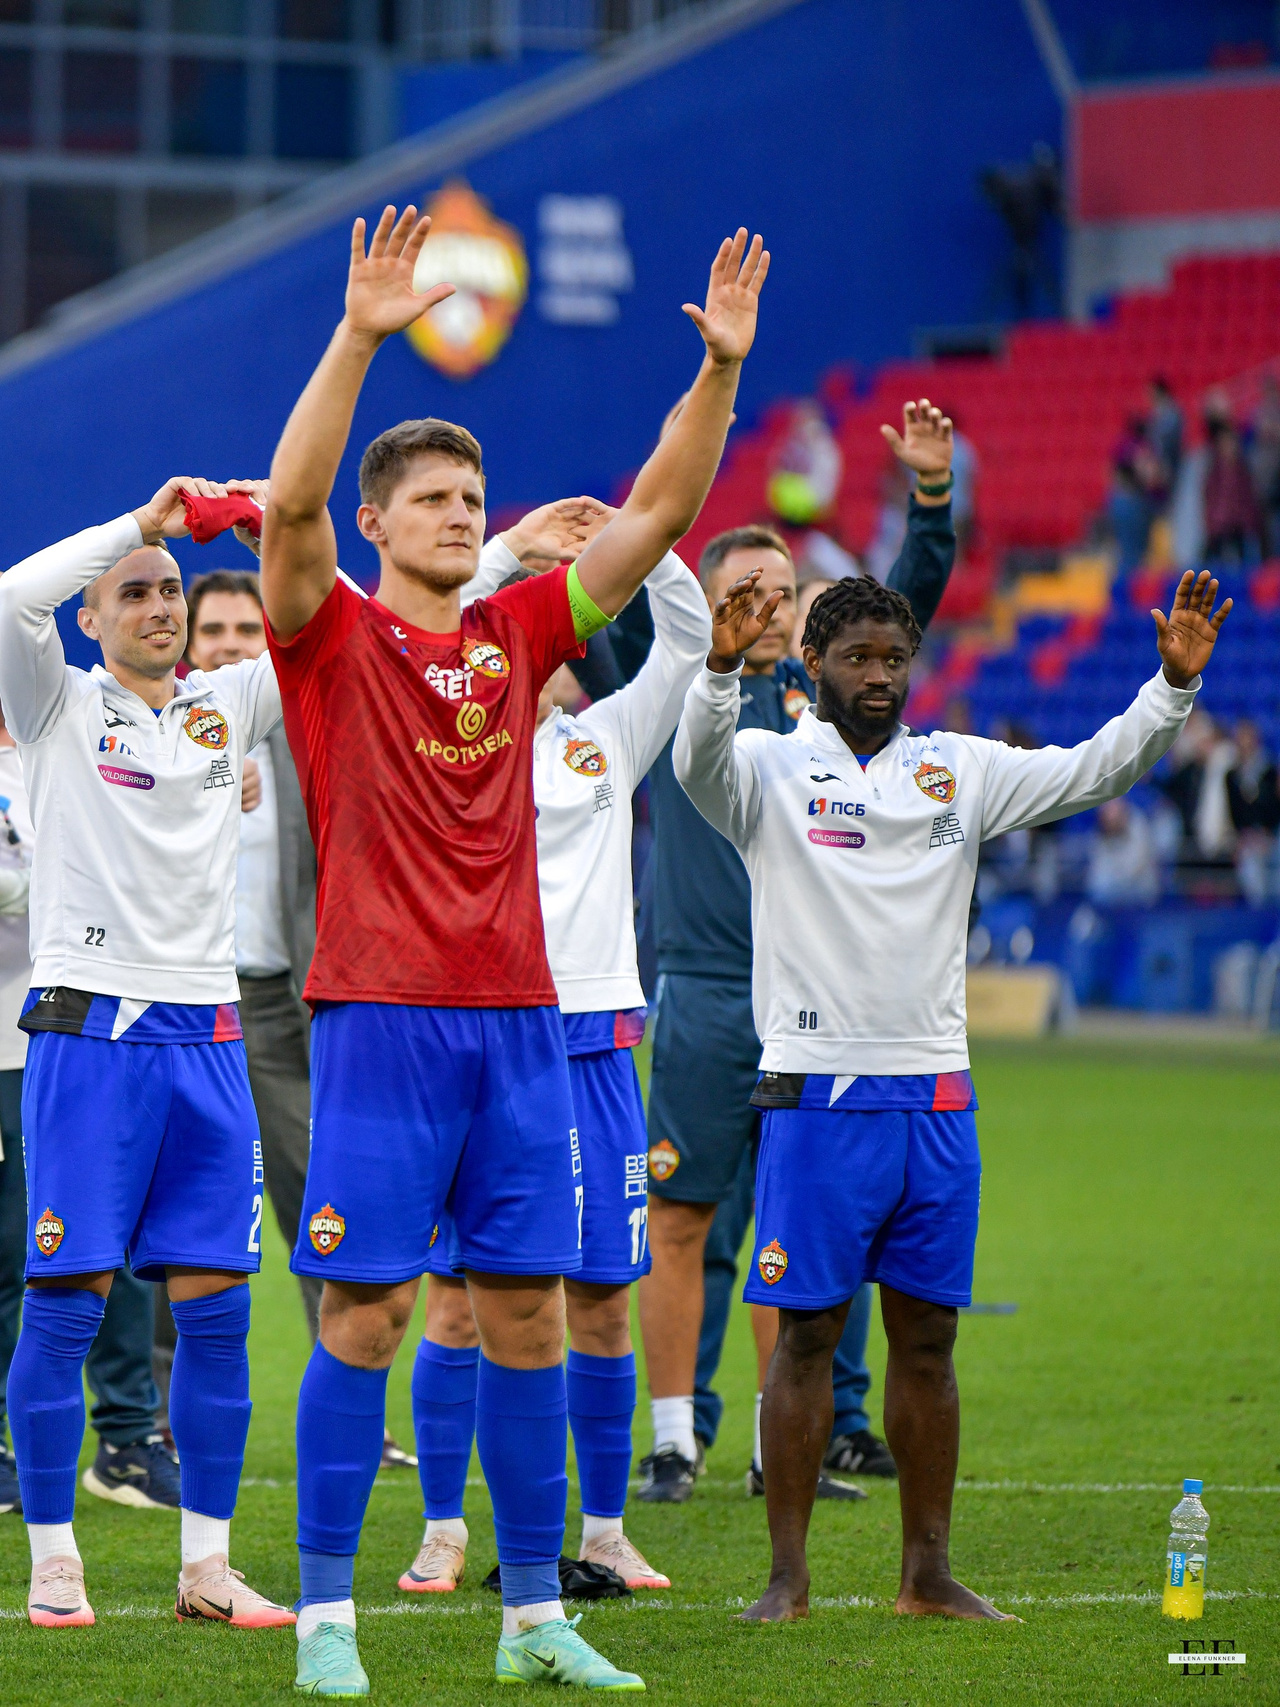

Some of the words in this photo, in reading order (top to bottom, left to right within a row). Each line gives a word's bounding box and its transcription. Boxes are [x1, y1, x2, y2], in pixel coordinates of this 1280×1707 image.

[190, 715, 224, 738] ЦСКА
[100, 768, 151, 786] WILDBERRIES
[920, 771, 952, 788] ЦСКА
[831, 801, 866, 816] ПСБ
[932, 813, 960, 831] ВЭБ
[811, 832, 862, 844] WILDBERRIES
[84, 926, 106, 947] 22
[798, 1010, 818, 1030] 90
[311, 1218, 342, 1234] ЦСКА
[760, 1251, 785, 1267] ЦСКА
[1172, 1554, 1183, 1585] Vorgol
